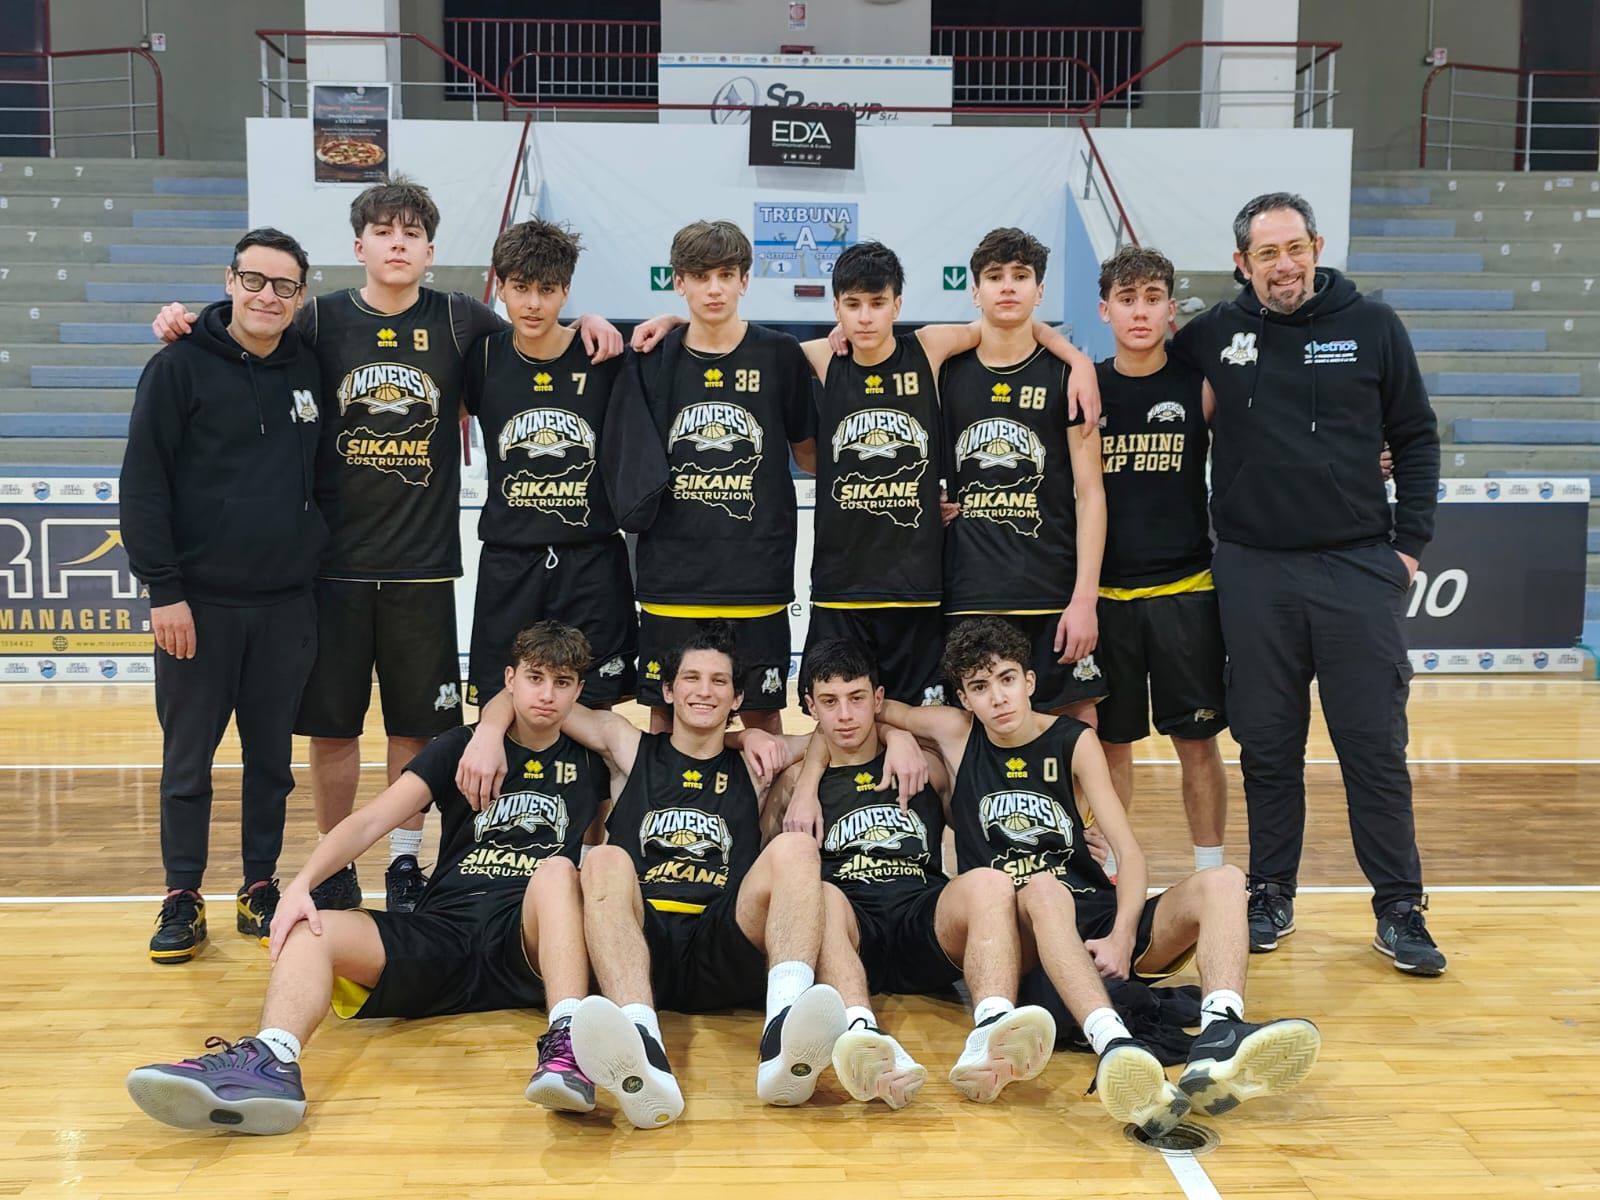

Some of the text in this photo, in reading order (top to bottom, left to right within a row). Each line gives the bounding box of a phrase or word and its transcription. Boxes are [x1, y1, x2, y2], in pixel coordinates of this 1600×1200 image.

[772, 120, 832, 144] EDA
[74, 166, 84, 177] 7
[1497, 182, 1506, 192] 7
[51, 197, 61, 208] 7
[760, 207, 852, 223] TRIBUNA
[1524, 211, 1533, 222] 7
[27, 231, 37, 242] 7
[794, 225, 818, 251] A
[1553, 243, 1562, 254] 7
[0, 268, 10, 279] 7
[313, 270, 323, 282] 4
[778, 263, 785, 273] 1
[826, 263, 834, 273] 2
[425, 271, 434, 283] 2
[1584, 279, 1594, 290] 7
[413, 328, 429, 351] 9
[351, 365, 426, 399] MINERS
[571, 372, 587, 395] 7
[892, 371, 920, 397] 18
[511, 410, 582, 445] MINERS
[679, 404, 749, 436] MINERS
[843, 411, 913, 444] MINERS
[966, 420, 1031, 455] MINERS
[1102, 433, 1185, 454] RAINING
[346, 439, 430, 456] SIKANE
[346, 456, 432, 466] COSTRUZIONI
[1103, 454, 1183, 473] MP 2024
[510, 481, 588, 497] SIKANE
[674, 474, 753, 490] SIKANE
[840, 482, 920, 500] SIKANE
[840, 499, 920, 510] COSTRUZIONI
[963, 492, 1038, 509] SIKANE
[0, 608, 131, 630] MANAGER
[554, 760, 577, 785] 15
[1043, 757, 1058, 782] 0
[647, 811, 721, 843] MINERS
[839, 807, 915, 847] MINERS
[460, 864, 534, 877] COSTRUZIO
[644, 861, 729, 888] SIKANE
